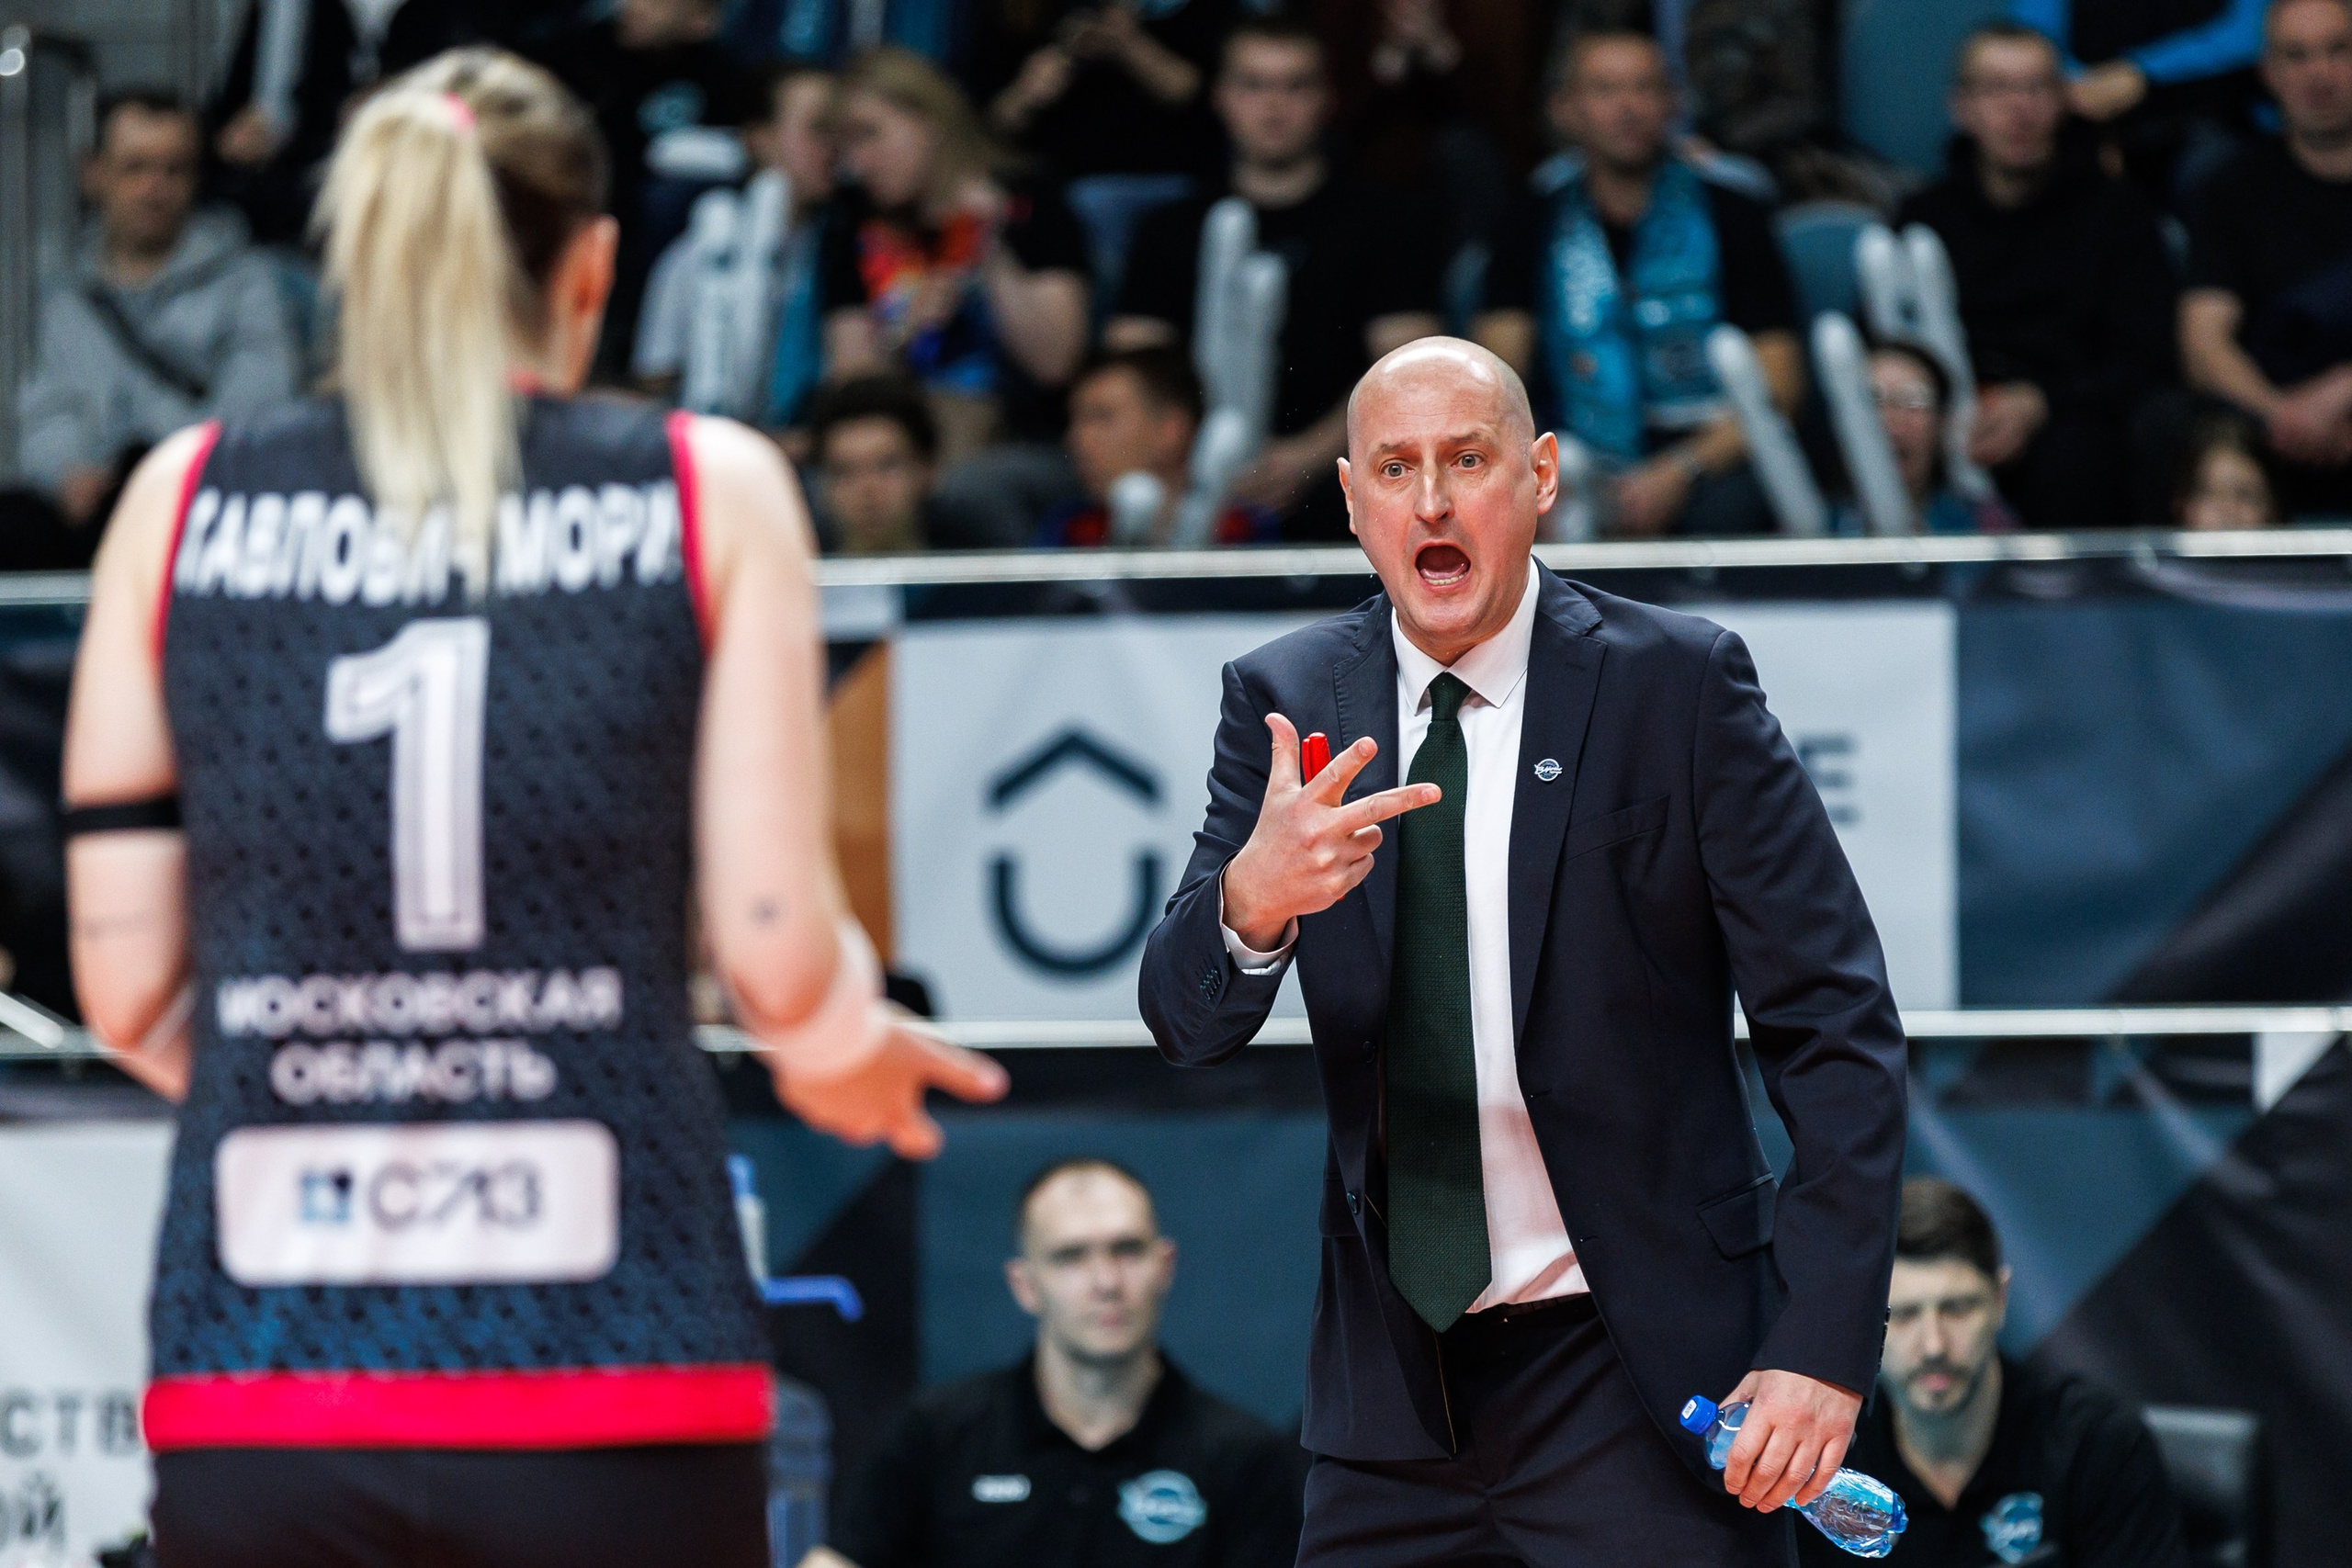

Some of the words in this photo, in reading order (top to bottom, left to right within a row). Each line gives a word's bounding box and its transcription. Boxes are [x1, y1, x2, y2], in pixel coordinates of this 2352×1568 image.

[326, 617, 490, 952] 1
[218, 966, 622, 1037] МОСКОВСКАЯ
[270, 1039, 557, 1105] ОБЛАСТЬ
